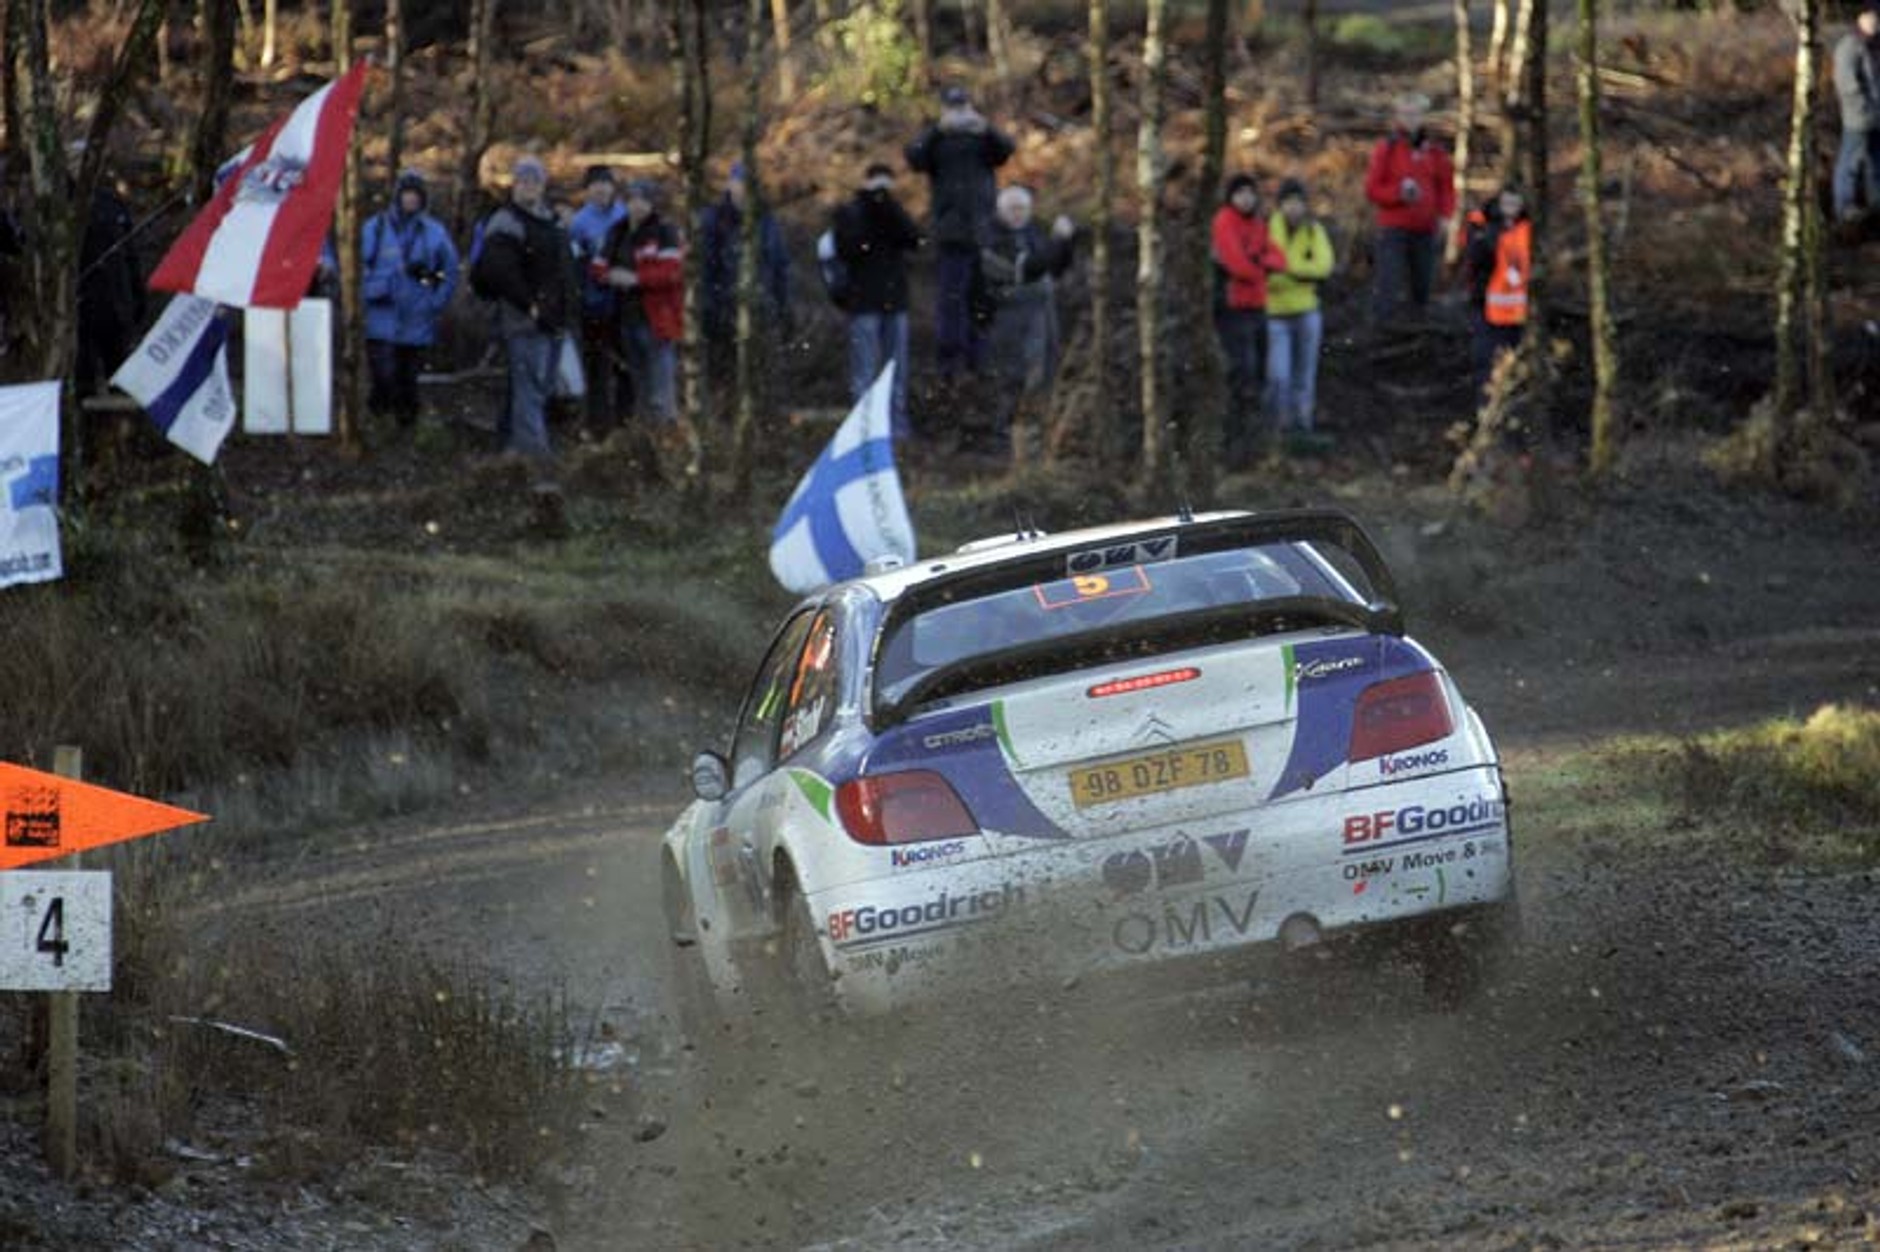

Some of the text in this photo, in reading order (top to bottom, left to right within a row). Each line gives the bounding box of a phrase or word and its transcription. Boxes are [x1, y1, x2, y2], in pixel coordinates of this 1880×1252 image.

[1073, 572, 1110, 598] 5
[1087, 769, 1121, 798] 98
[1194, 749, 1230, 775] 78
[1380, 749, 1449, 776] KRONOS
[891, 840, 966, 867] KRONOS
[1344, 856, 1394, 881] OMV
[1403, 848, 1456, 871] Move
[828, 882, 1025, 940] BFGoodrich
[1113, 888, 1259, 954] OMV
[37, 897, 69, 967] 4
